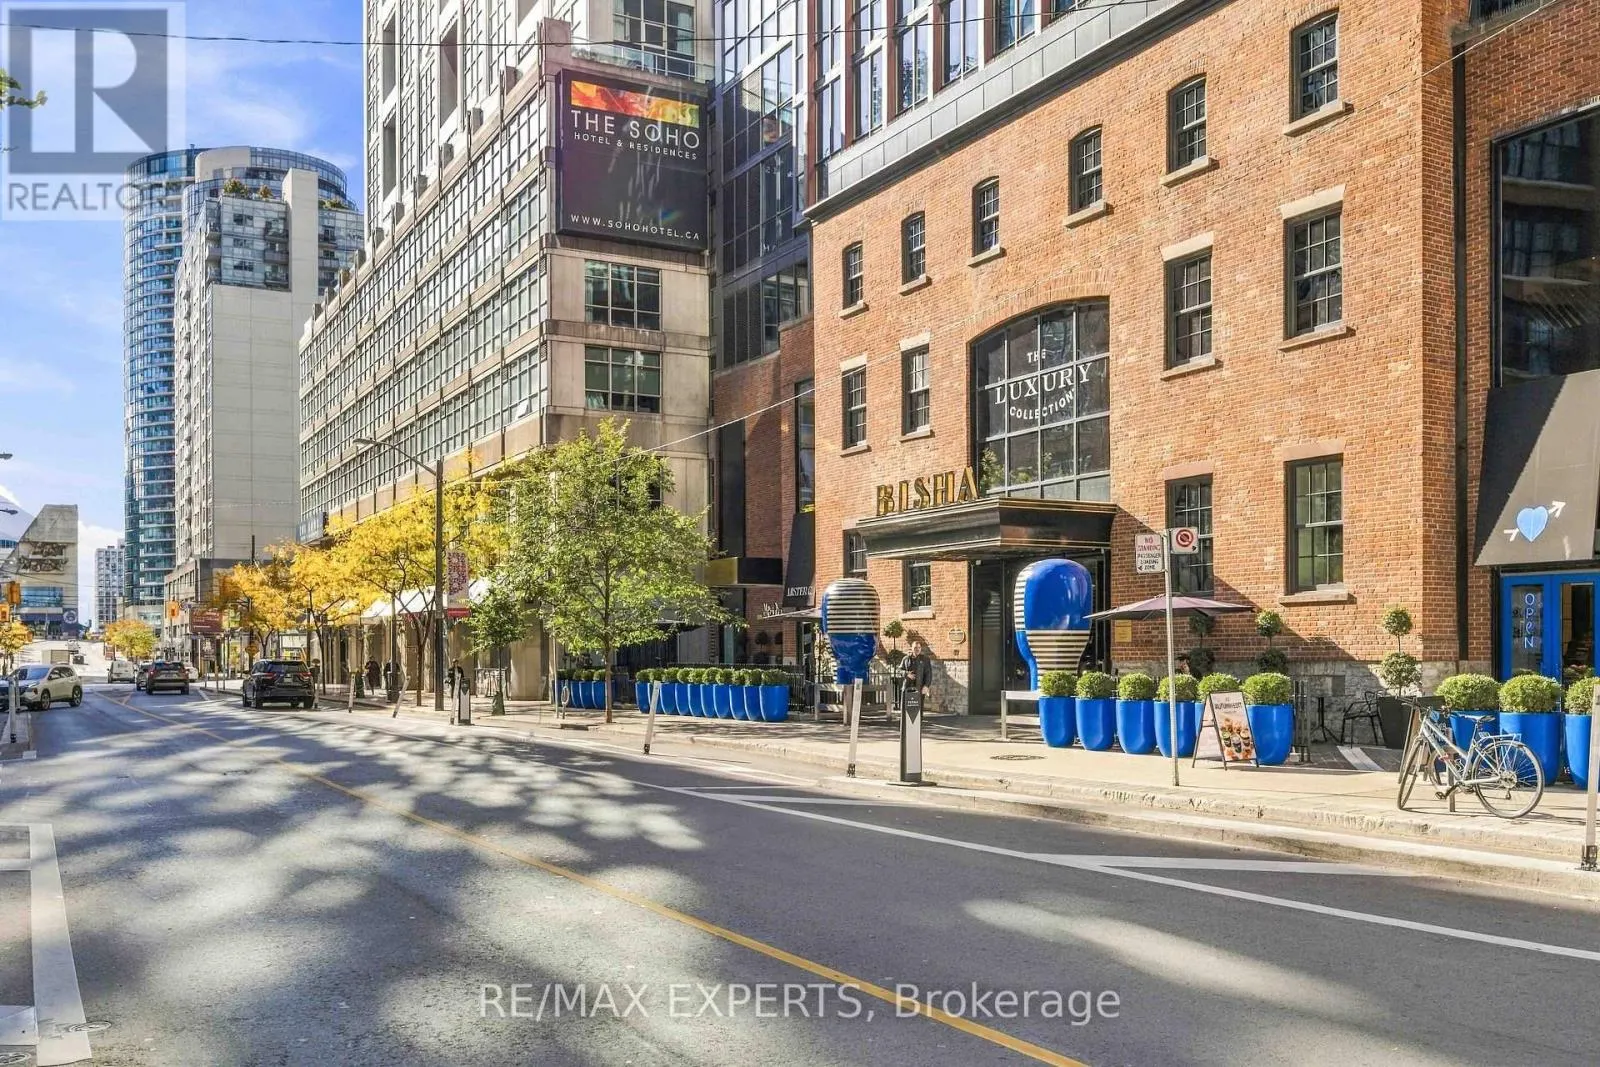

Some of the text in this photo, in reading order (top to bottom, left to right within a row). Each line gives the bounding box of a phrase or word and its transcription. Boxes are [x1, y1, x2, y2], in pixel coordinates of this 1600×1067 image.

[571, 110, 700, 149] THE SOHO
[574, 132, 697, 160] HOTEL & RESIDENCES
[571, 214, 700, 241] WWW.SOHOHOTEL.CA
[1027, 348, 1046, 364] THE
[995, 362, 1093, 405] LUXURY
[1009, 388, 1076, 420] COLLECTION
[877, 466, 980, 516] BISHA
